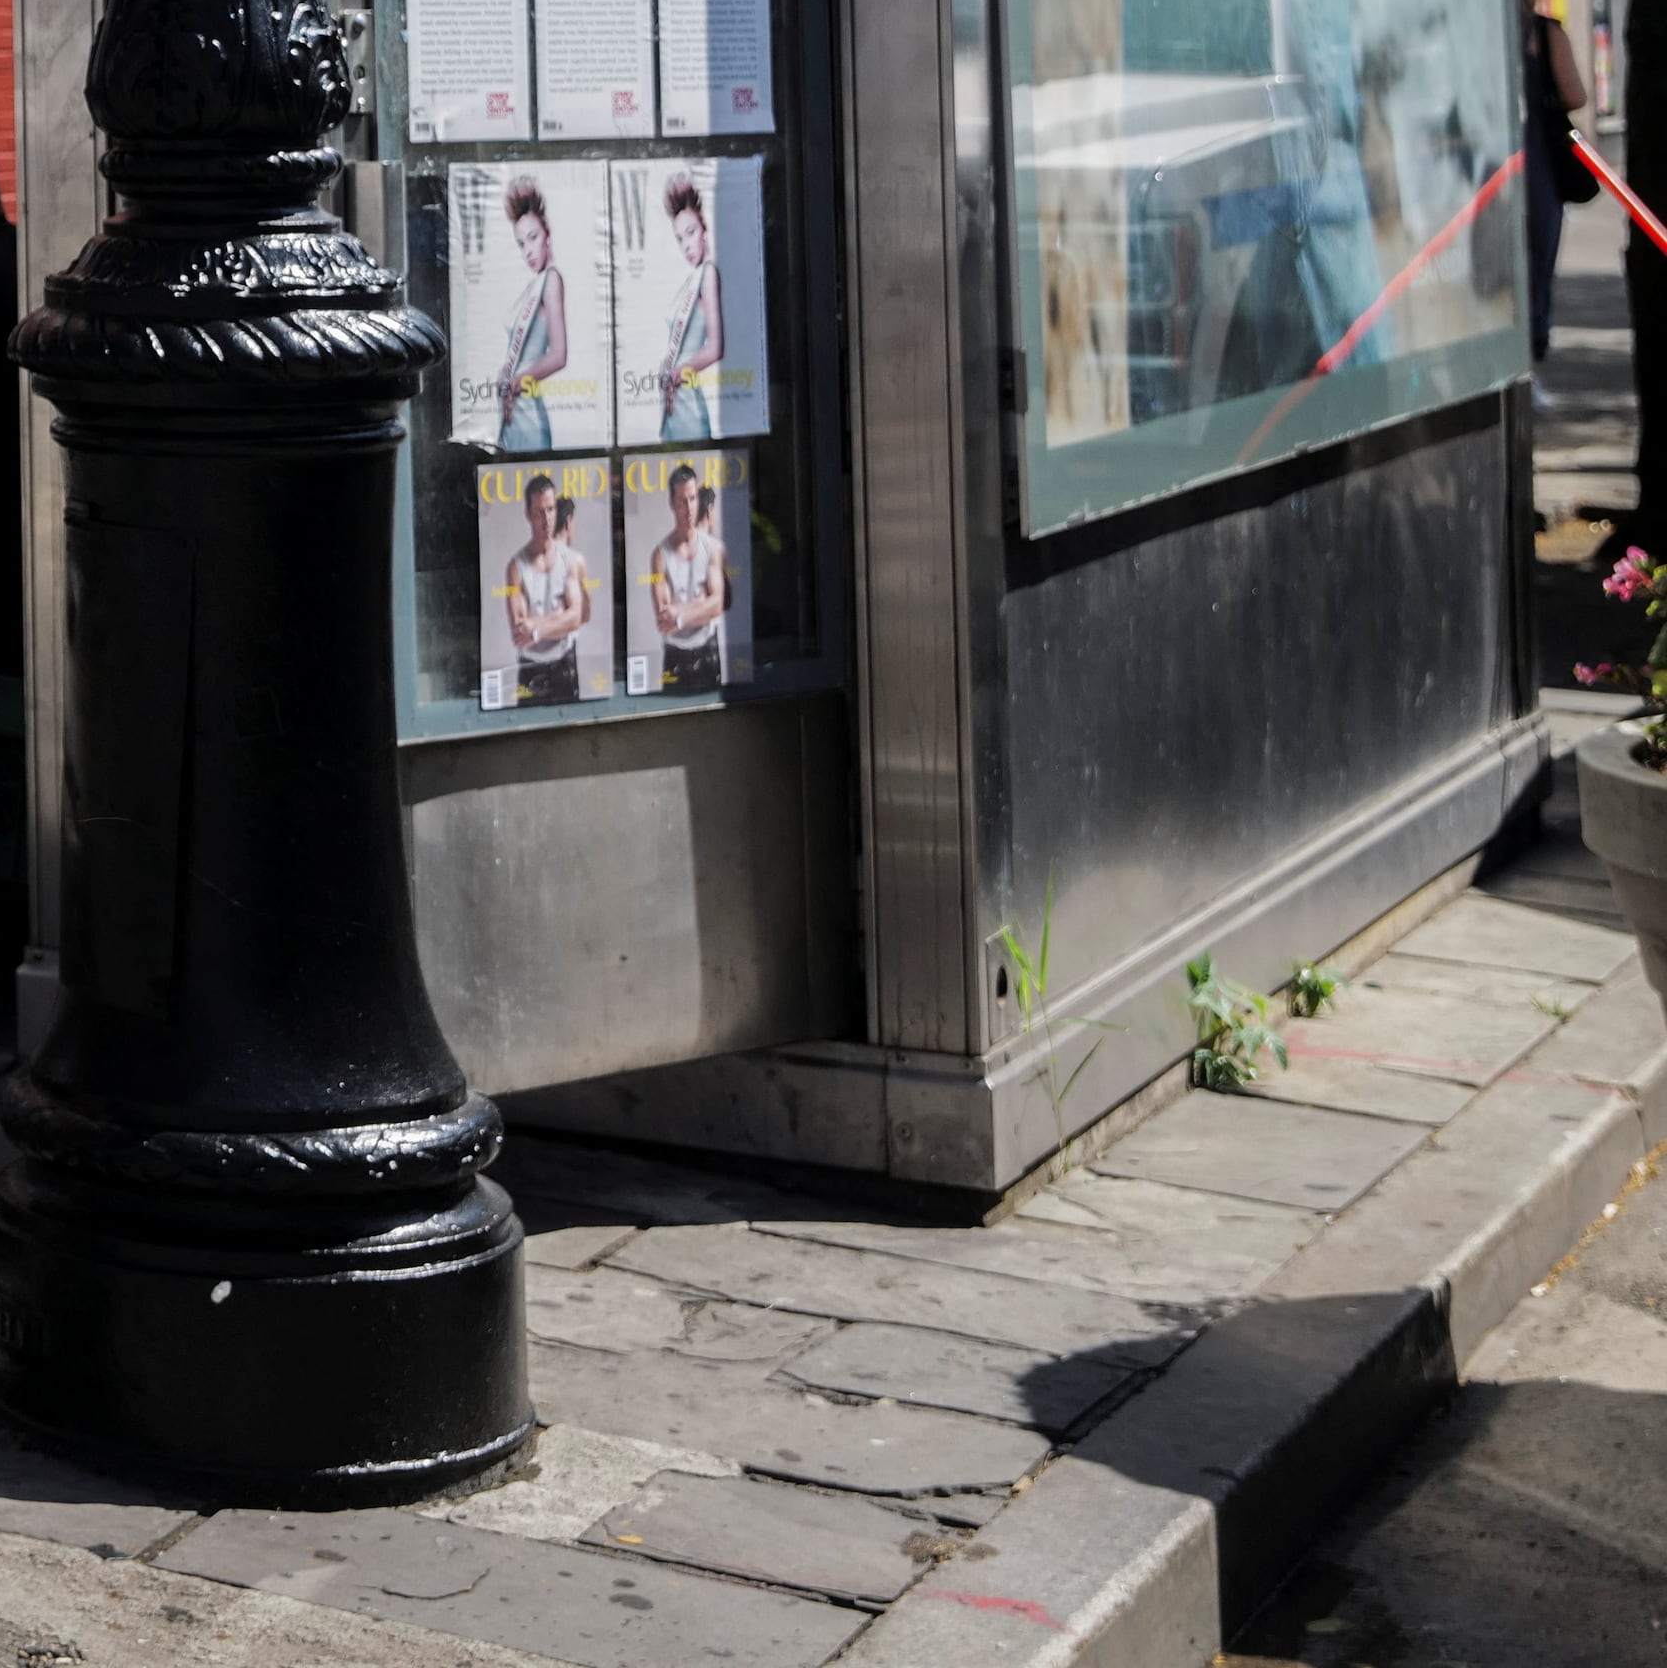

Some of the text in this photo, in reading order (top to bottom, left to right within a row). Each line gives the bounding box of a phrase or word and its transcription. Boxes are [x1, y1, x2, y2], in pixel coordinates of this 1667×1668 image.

[618, 169, 648, 250] W
[459, 374, 598, 404] Sydney Sweeney
[624, 366, 754, 396] Sydney Sweeney
[481, 465, 608, 504] CULRED
[626, 457, 748, 494] CULRED
